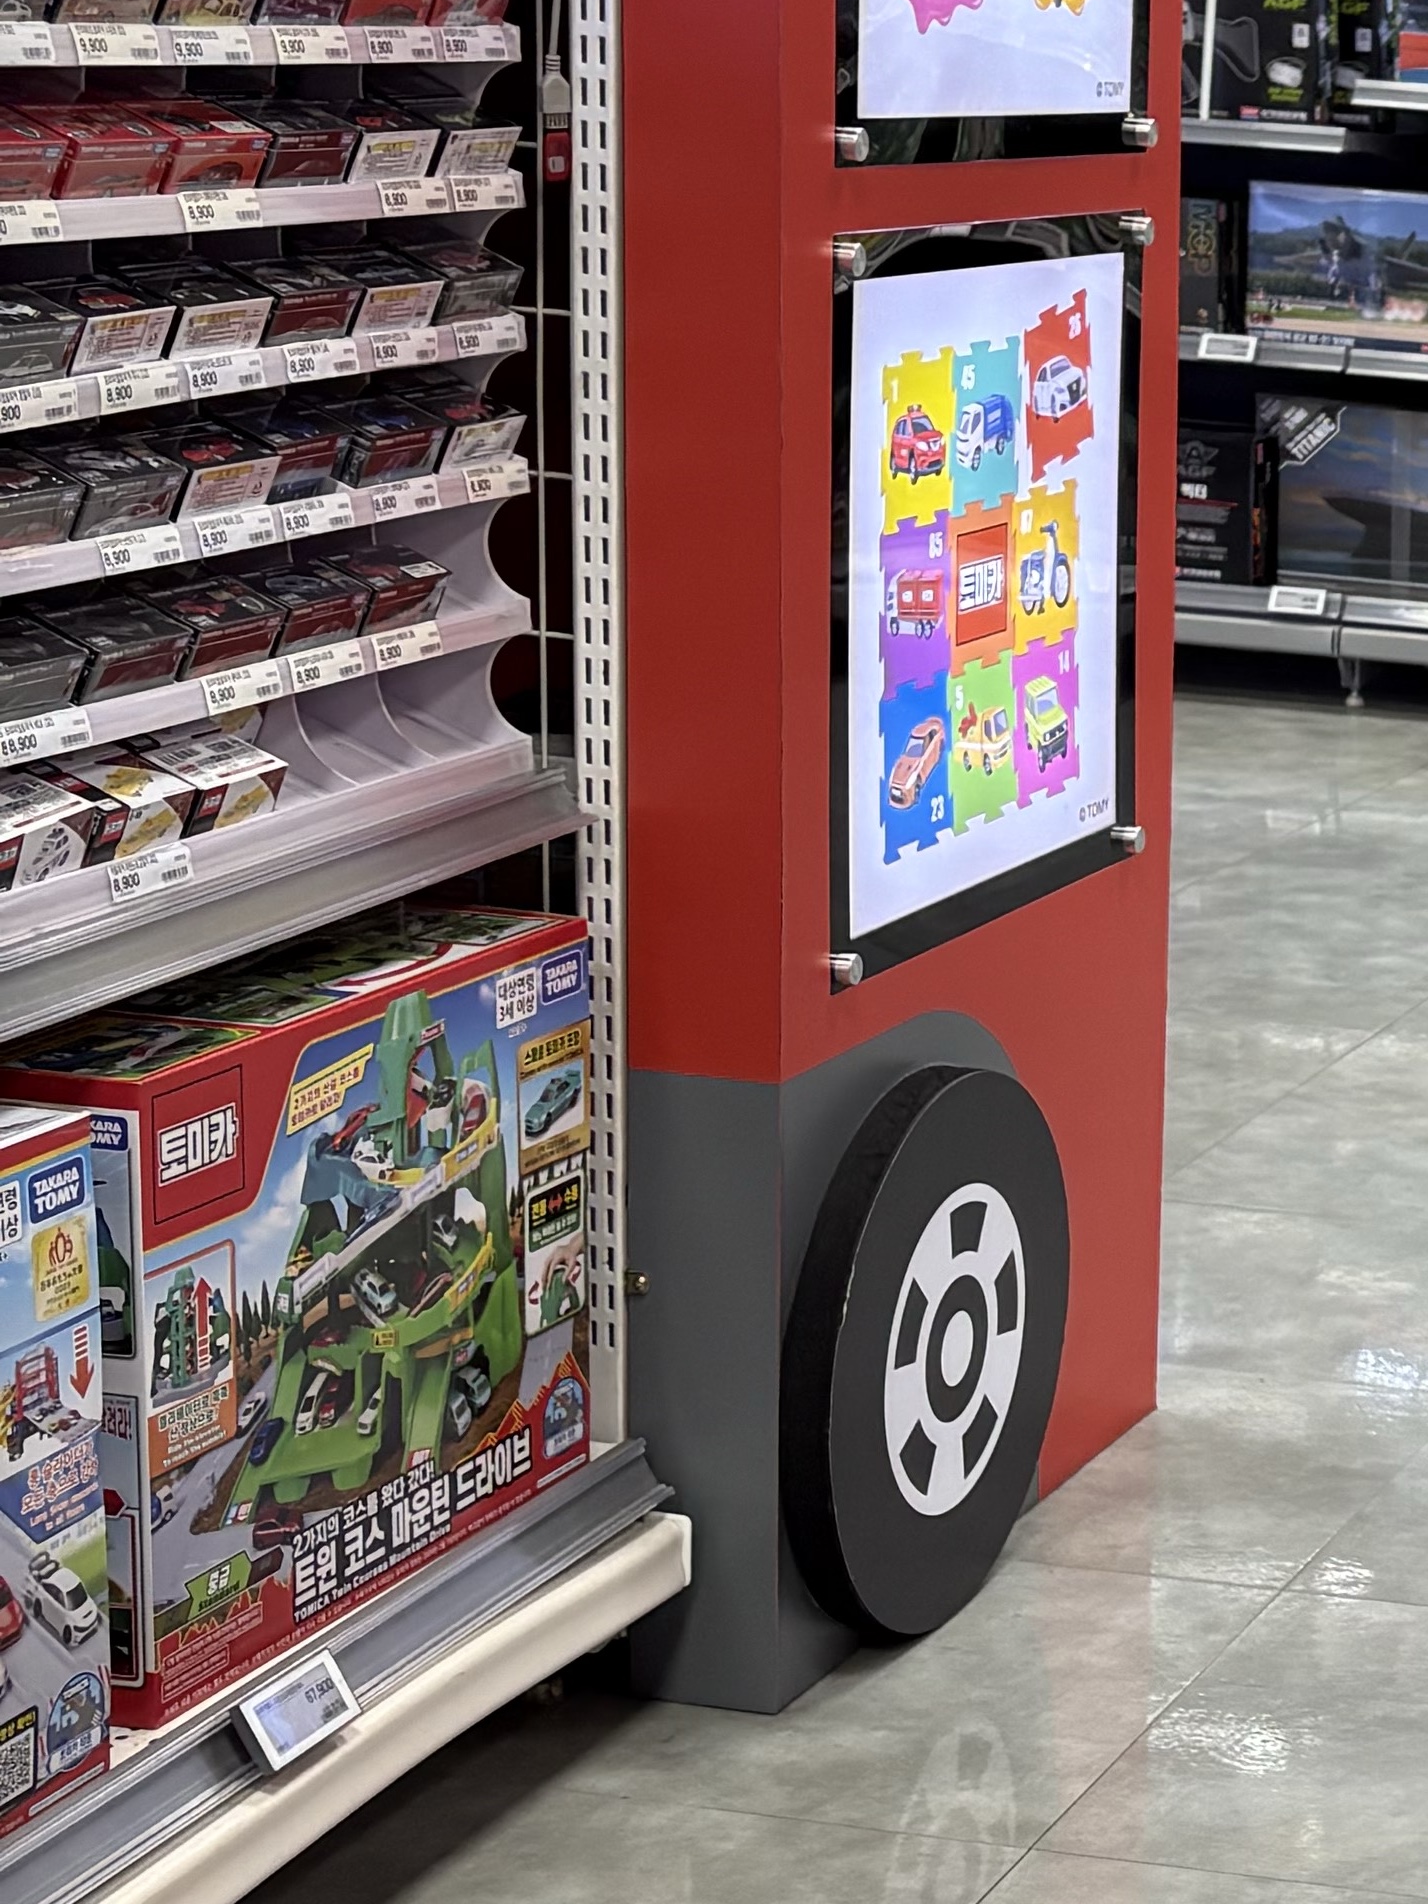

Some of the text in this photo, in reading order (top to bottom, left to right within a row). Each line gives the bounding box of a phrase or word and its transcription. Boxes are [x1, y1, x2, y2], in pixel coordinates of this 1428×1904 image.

[544, 958, 577, 980] TAKARA
[545, 973, 578, 996] TOMY
[516, 994, 535, 1017] 이상
[90, 1118, 122, 1134] KARA
[90, 1131, 122, 1146] OMY
[158, 1102, 238, 1187] 토미카
[33, 1166, 80, 1196] TAKARA
[34, 1182, 80, 1214] TOMY
[293, 1514, 340, 1559] 2가지의
[342, 1491, 380, 1531] 코스를
[294, 1427, 532, 1608] 트윈 코스 마운틴 드라이브
[294, 1590, 331, 1624] TOMICA
[331, 1581, 352, 1602] Twin
[352, 1560, 389, 1590] Courses
[389, 1538, 428, 1567] Mountain
